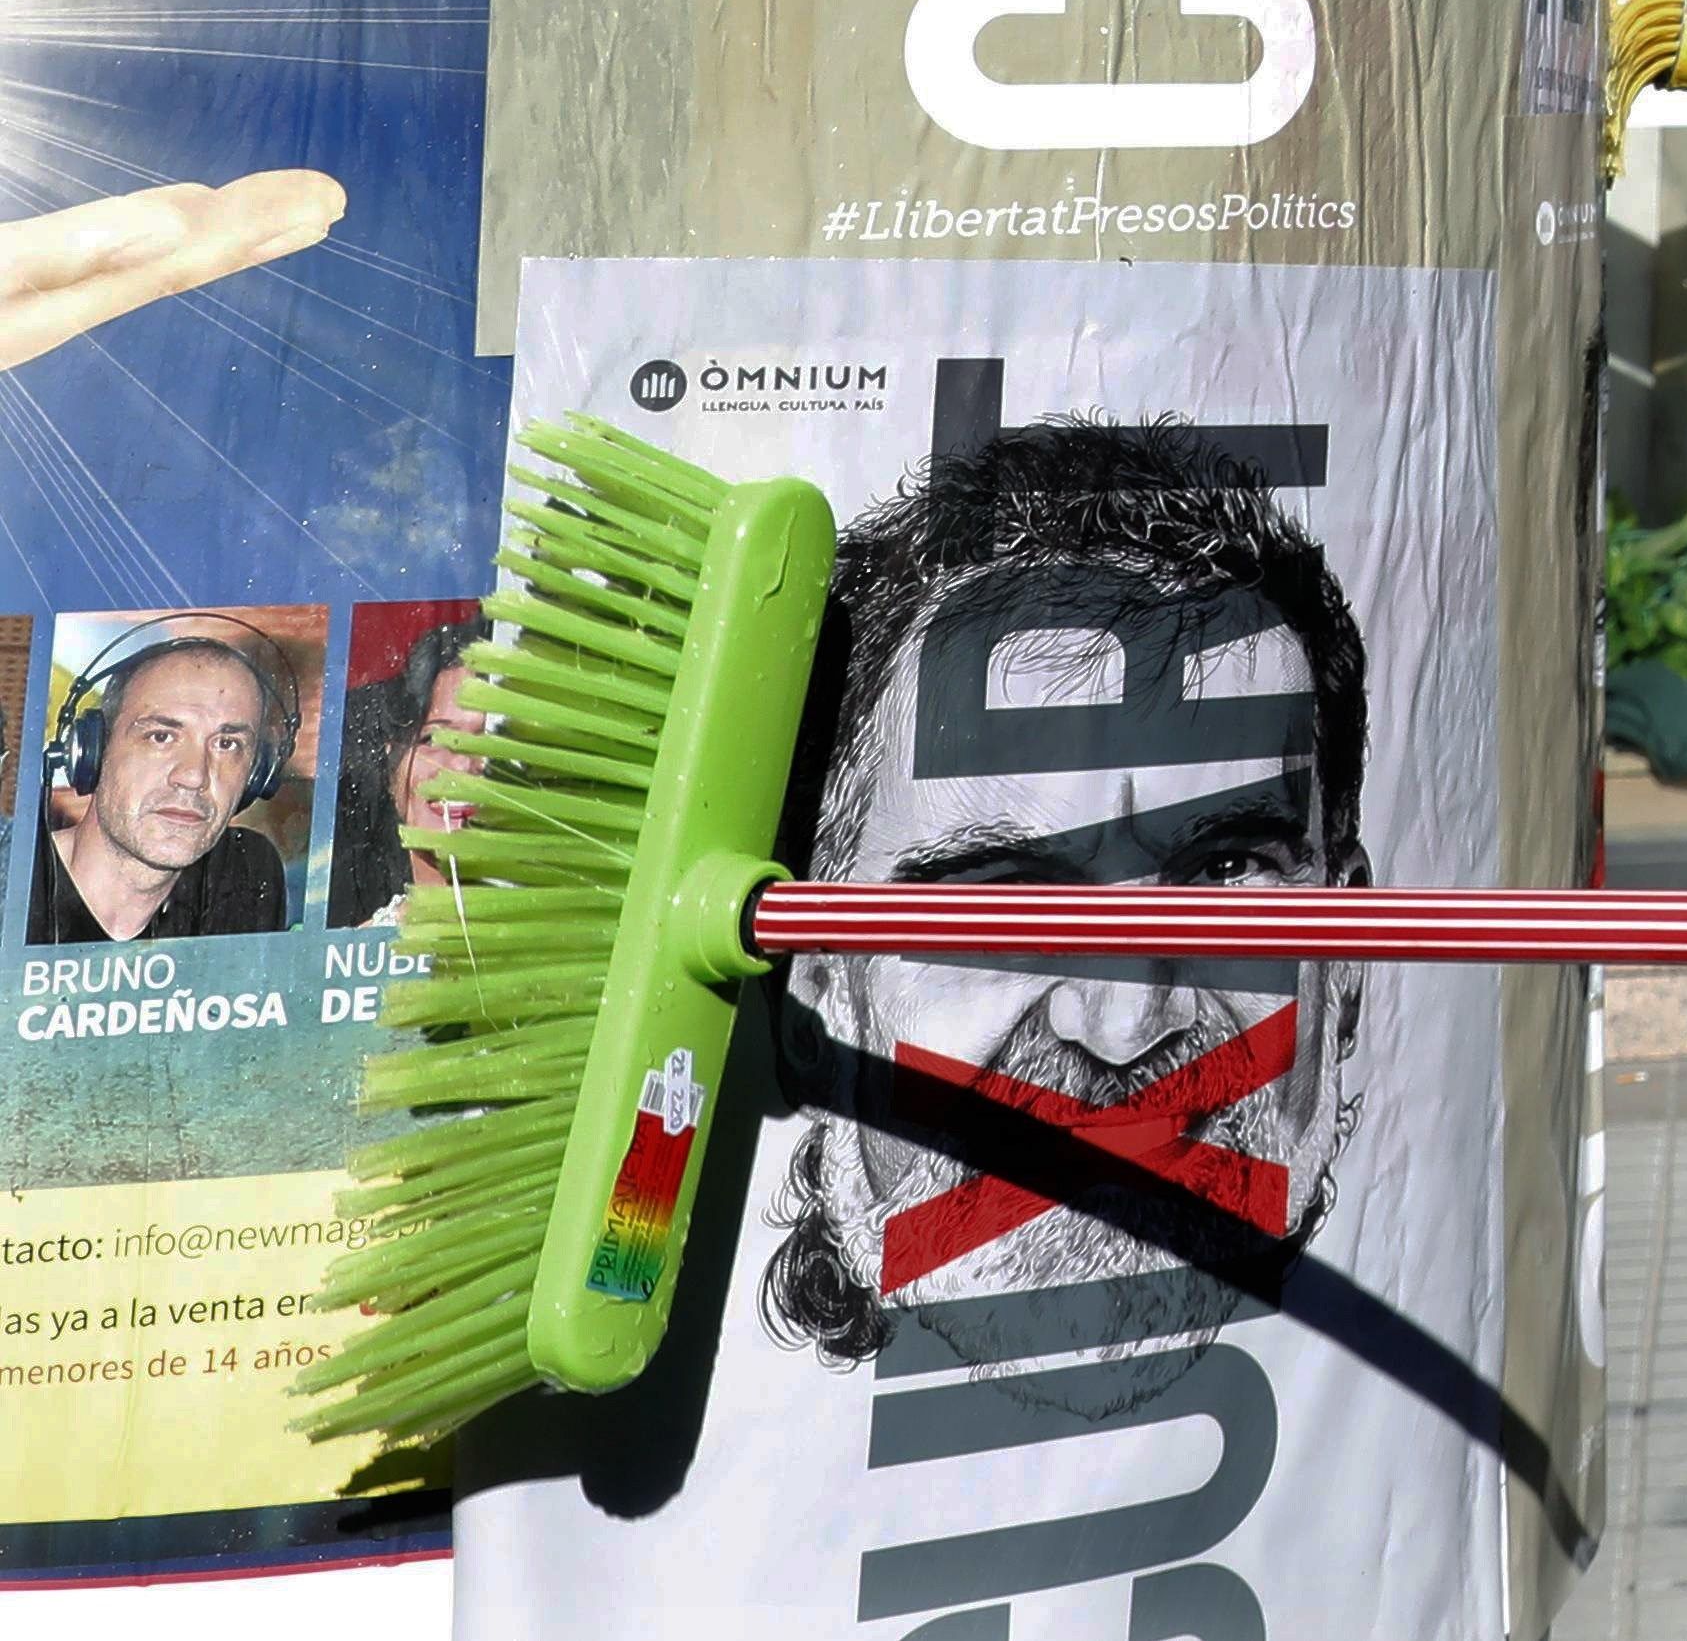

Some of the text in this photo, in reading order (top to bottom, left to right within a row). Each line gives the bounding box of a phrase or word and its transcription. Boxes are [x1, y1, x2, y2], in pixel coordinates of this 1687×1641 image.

[822, 192, 1357, 241] #LlibertatPresosPolítics
[700, 359, 887, 391] ÒMNIUM
[702, 397, 884, 412] LLENGUA CULTURA PAÍS
[22, 953, 176, 996] BRUNO
[17, 988, 288, 1041] CARDEÑOSA
[321, 986, 378, 1024] DE
[2, 1233, 103, 1265] tacto:
[0, 1309, 40, 1335] as
[50, 1308, 89, 1340] ya
[101, 1310, 119, 1330] a
[130, 1297, 157, 1327] la
[168, 1292, 265, 1325] venta
[0, 1340, 331, 1386] menores de 14 años
